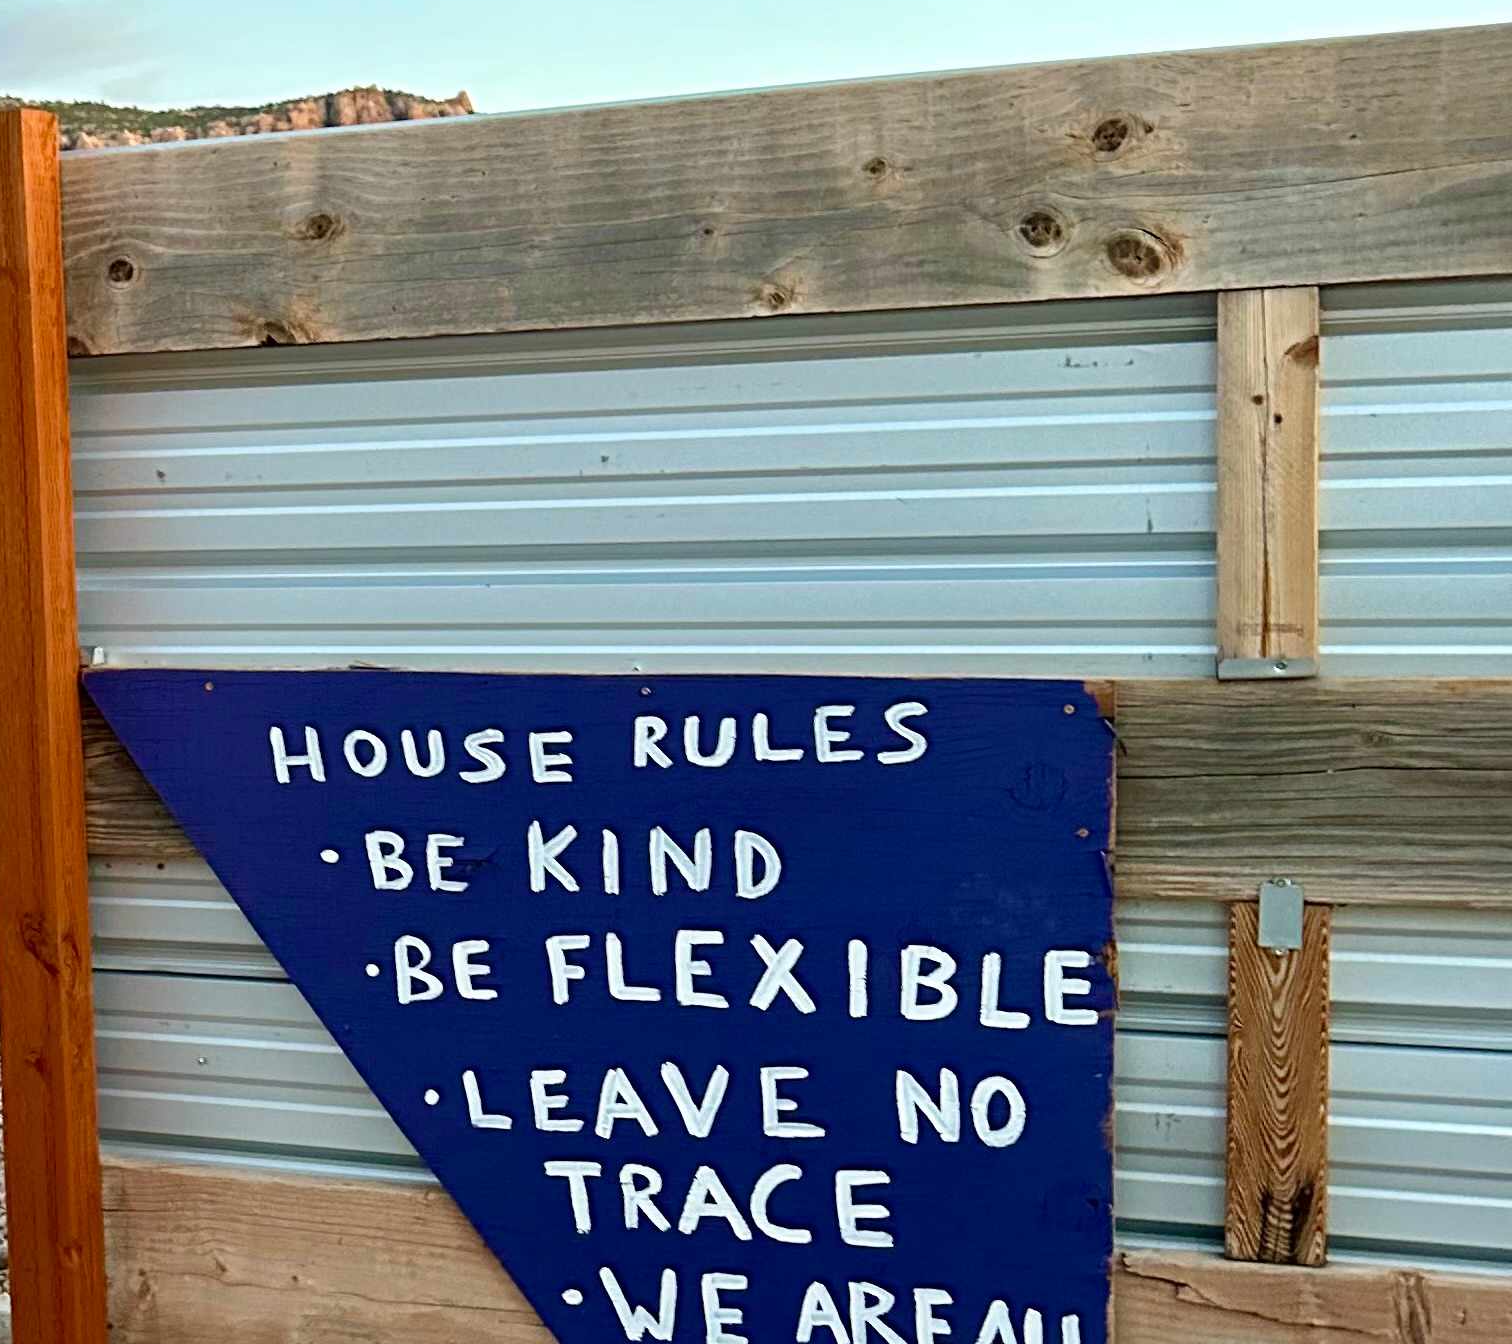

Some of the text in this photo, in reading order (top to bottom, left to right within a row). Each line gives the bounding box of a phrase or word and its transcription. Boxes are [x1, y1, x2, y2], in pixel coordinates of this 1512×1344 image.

[269, 701, 929, 784] HOUSE RULES
[365, 820, 782, 899] BE KIND
[394, 929, 1099, 1029] BE FLEXIBLE
[462, 1061, 1027, 1148] LEAVE NO
[543, 1160, 894, 1248] TRACE
